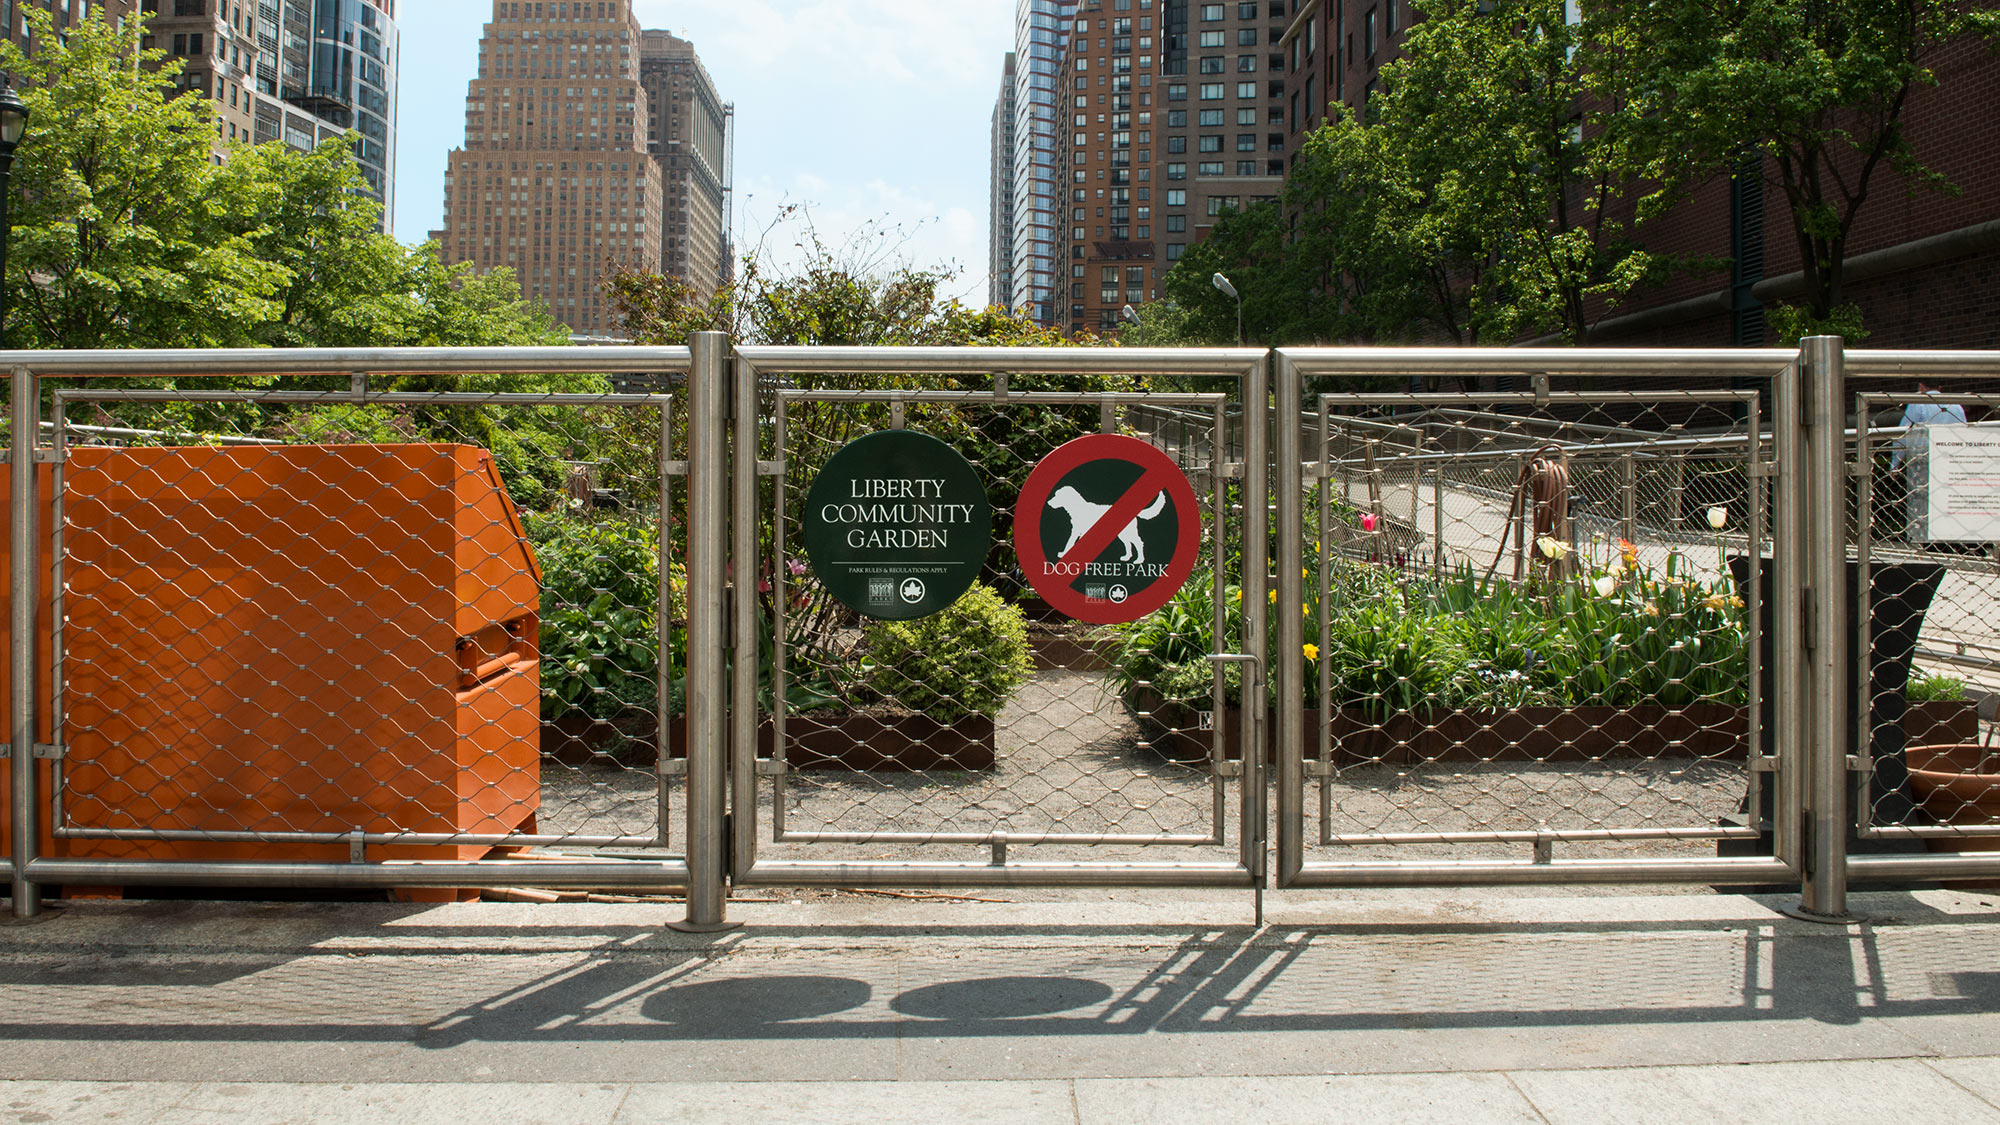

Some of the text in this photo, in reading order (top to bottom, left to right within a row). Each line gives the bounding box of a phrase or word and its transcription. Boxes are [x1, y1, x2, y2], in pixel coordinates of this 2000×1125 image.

[851, 479, 946, 498] LIBERTY
[821, 504, 974, 523] COMMUNITY
[847, 529, 948, 548] GARDEN
[1043, 562, 1169, 578] DOG FREE PARK
